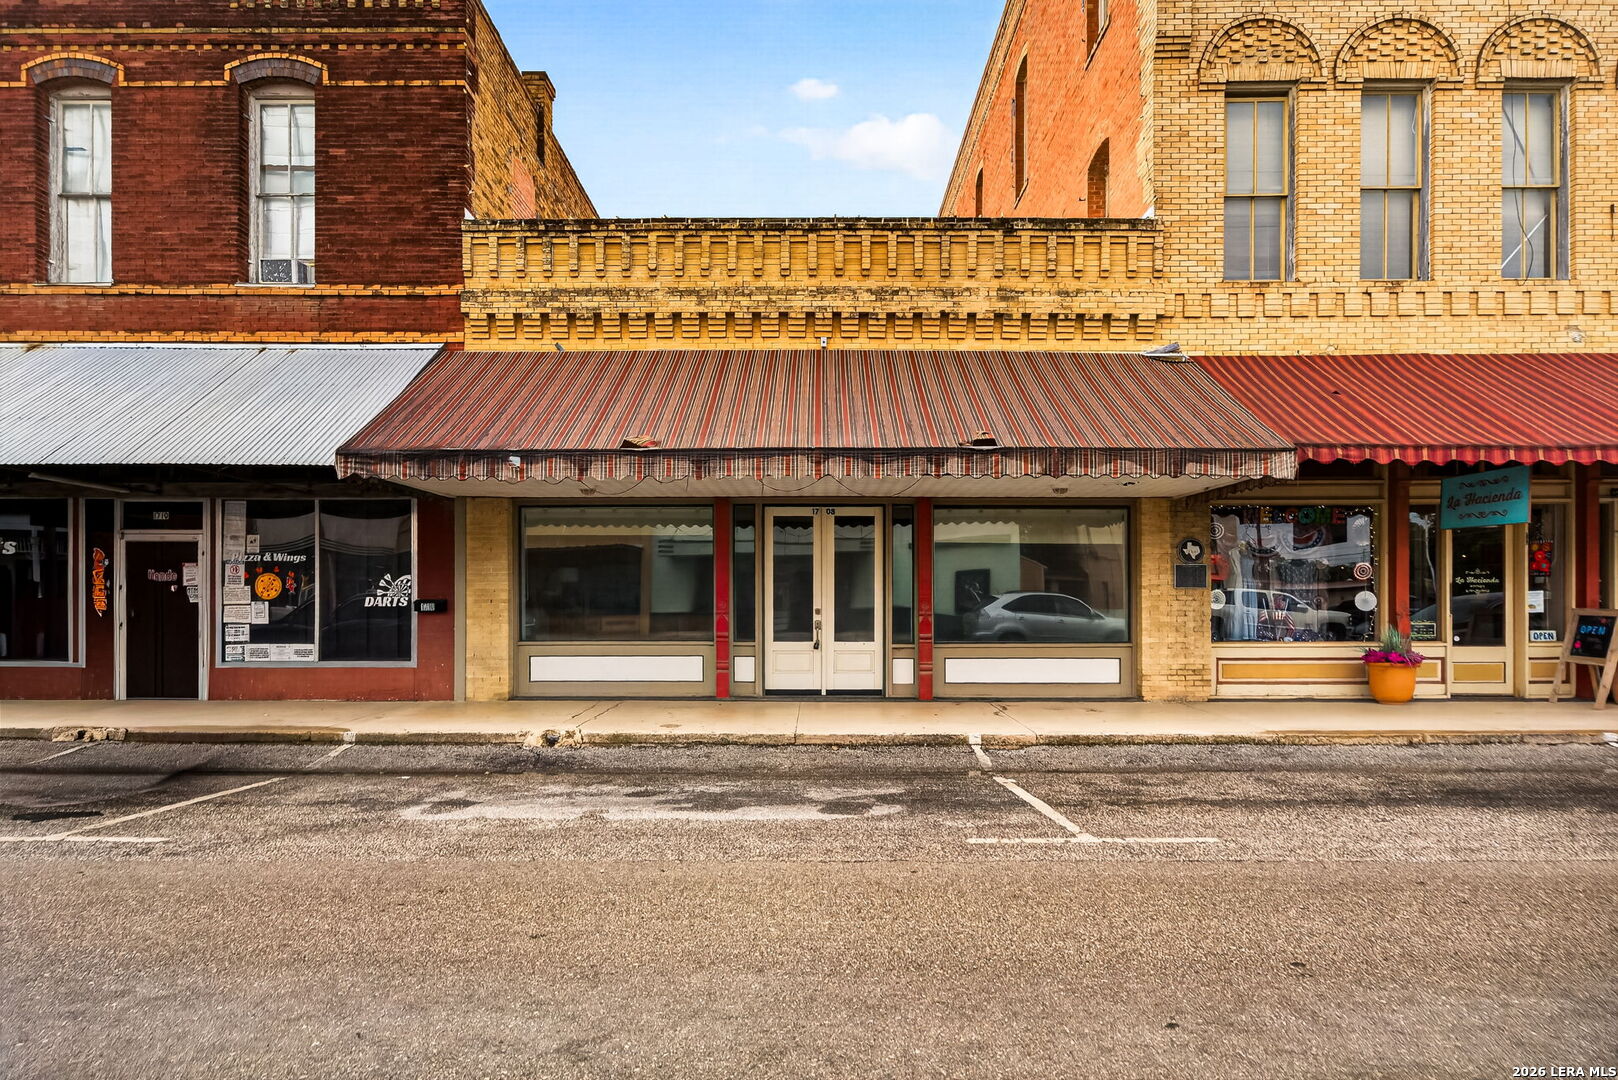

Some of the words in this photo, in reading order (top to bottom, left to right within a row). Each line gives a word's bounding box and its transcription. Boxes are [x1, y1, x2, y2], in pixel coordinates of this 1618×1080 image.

[1447, 495, 1461, 511] La
[1464, 487, 1522, 506] Hacienda
[263, 552, 272, 562] &
[273, 553, 307, 564] Wings
[364, 597, 409, 607] DARTS
[1532, 631, 1554, 641] OPEN
[1580, 625, 1606, 636] OPEN
